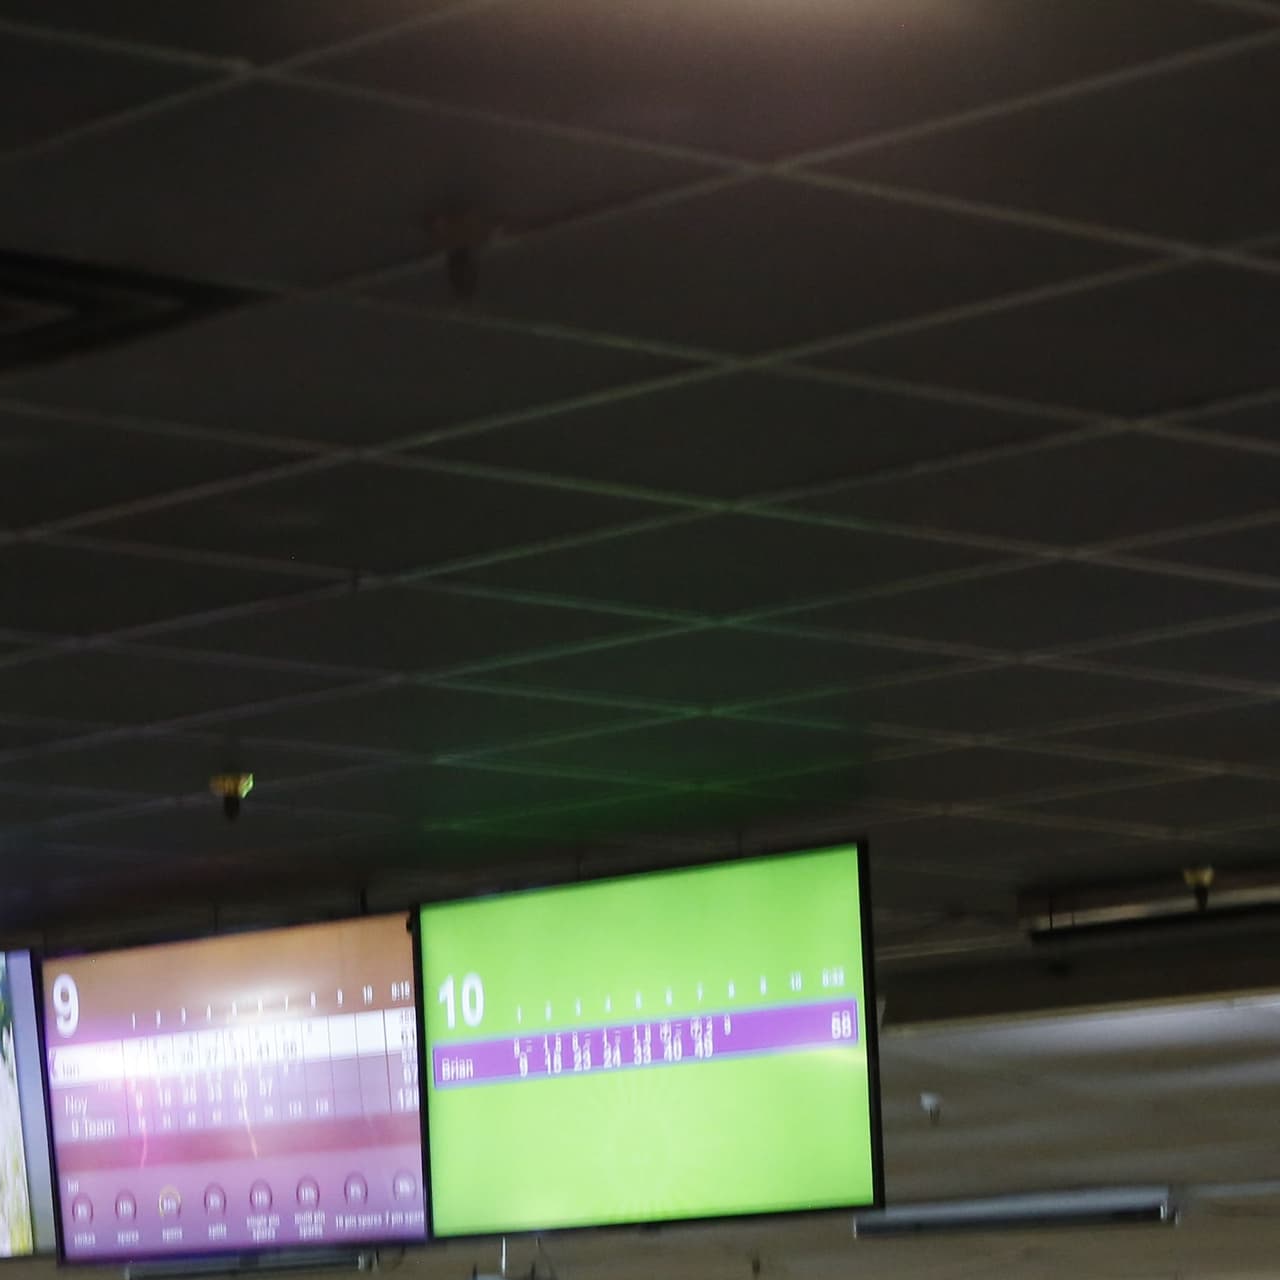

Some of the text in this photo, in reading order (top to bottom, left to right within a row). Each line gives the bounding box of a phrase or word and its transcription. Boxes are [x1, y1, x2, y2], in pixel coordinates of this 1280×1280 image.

[52, 973, 80, 1038] 9
[438, 972, 485, 1030] 10
[442, 1055, 474, 1081] Brian
